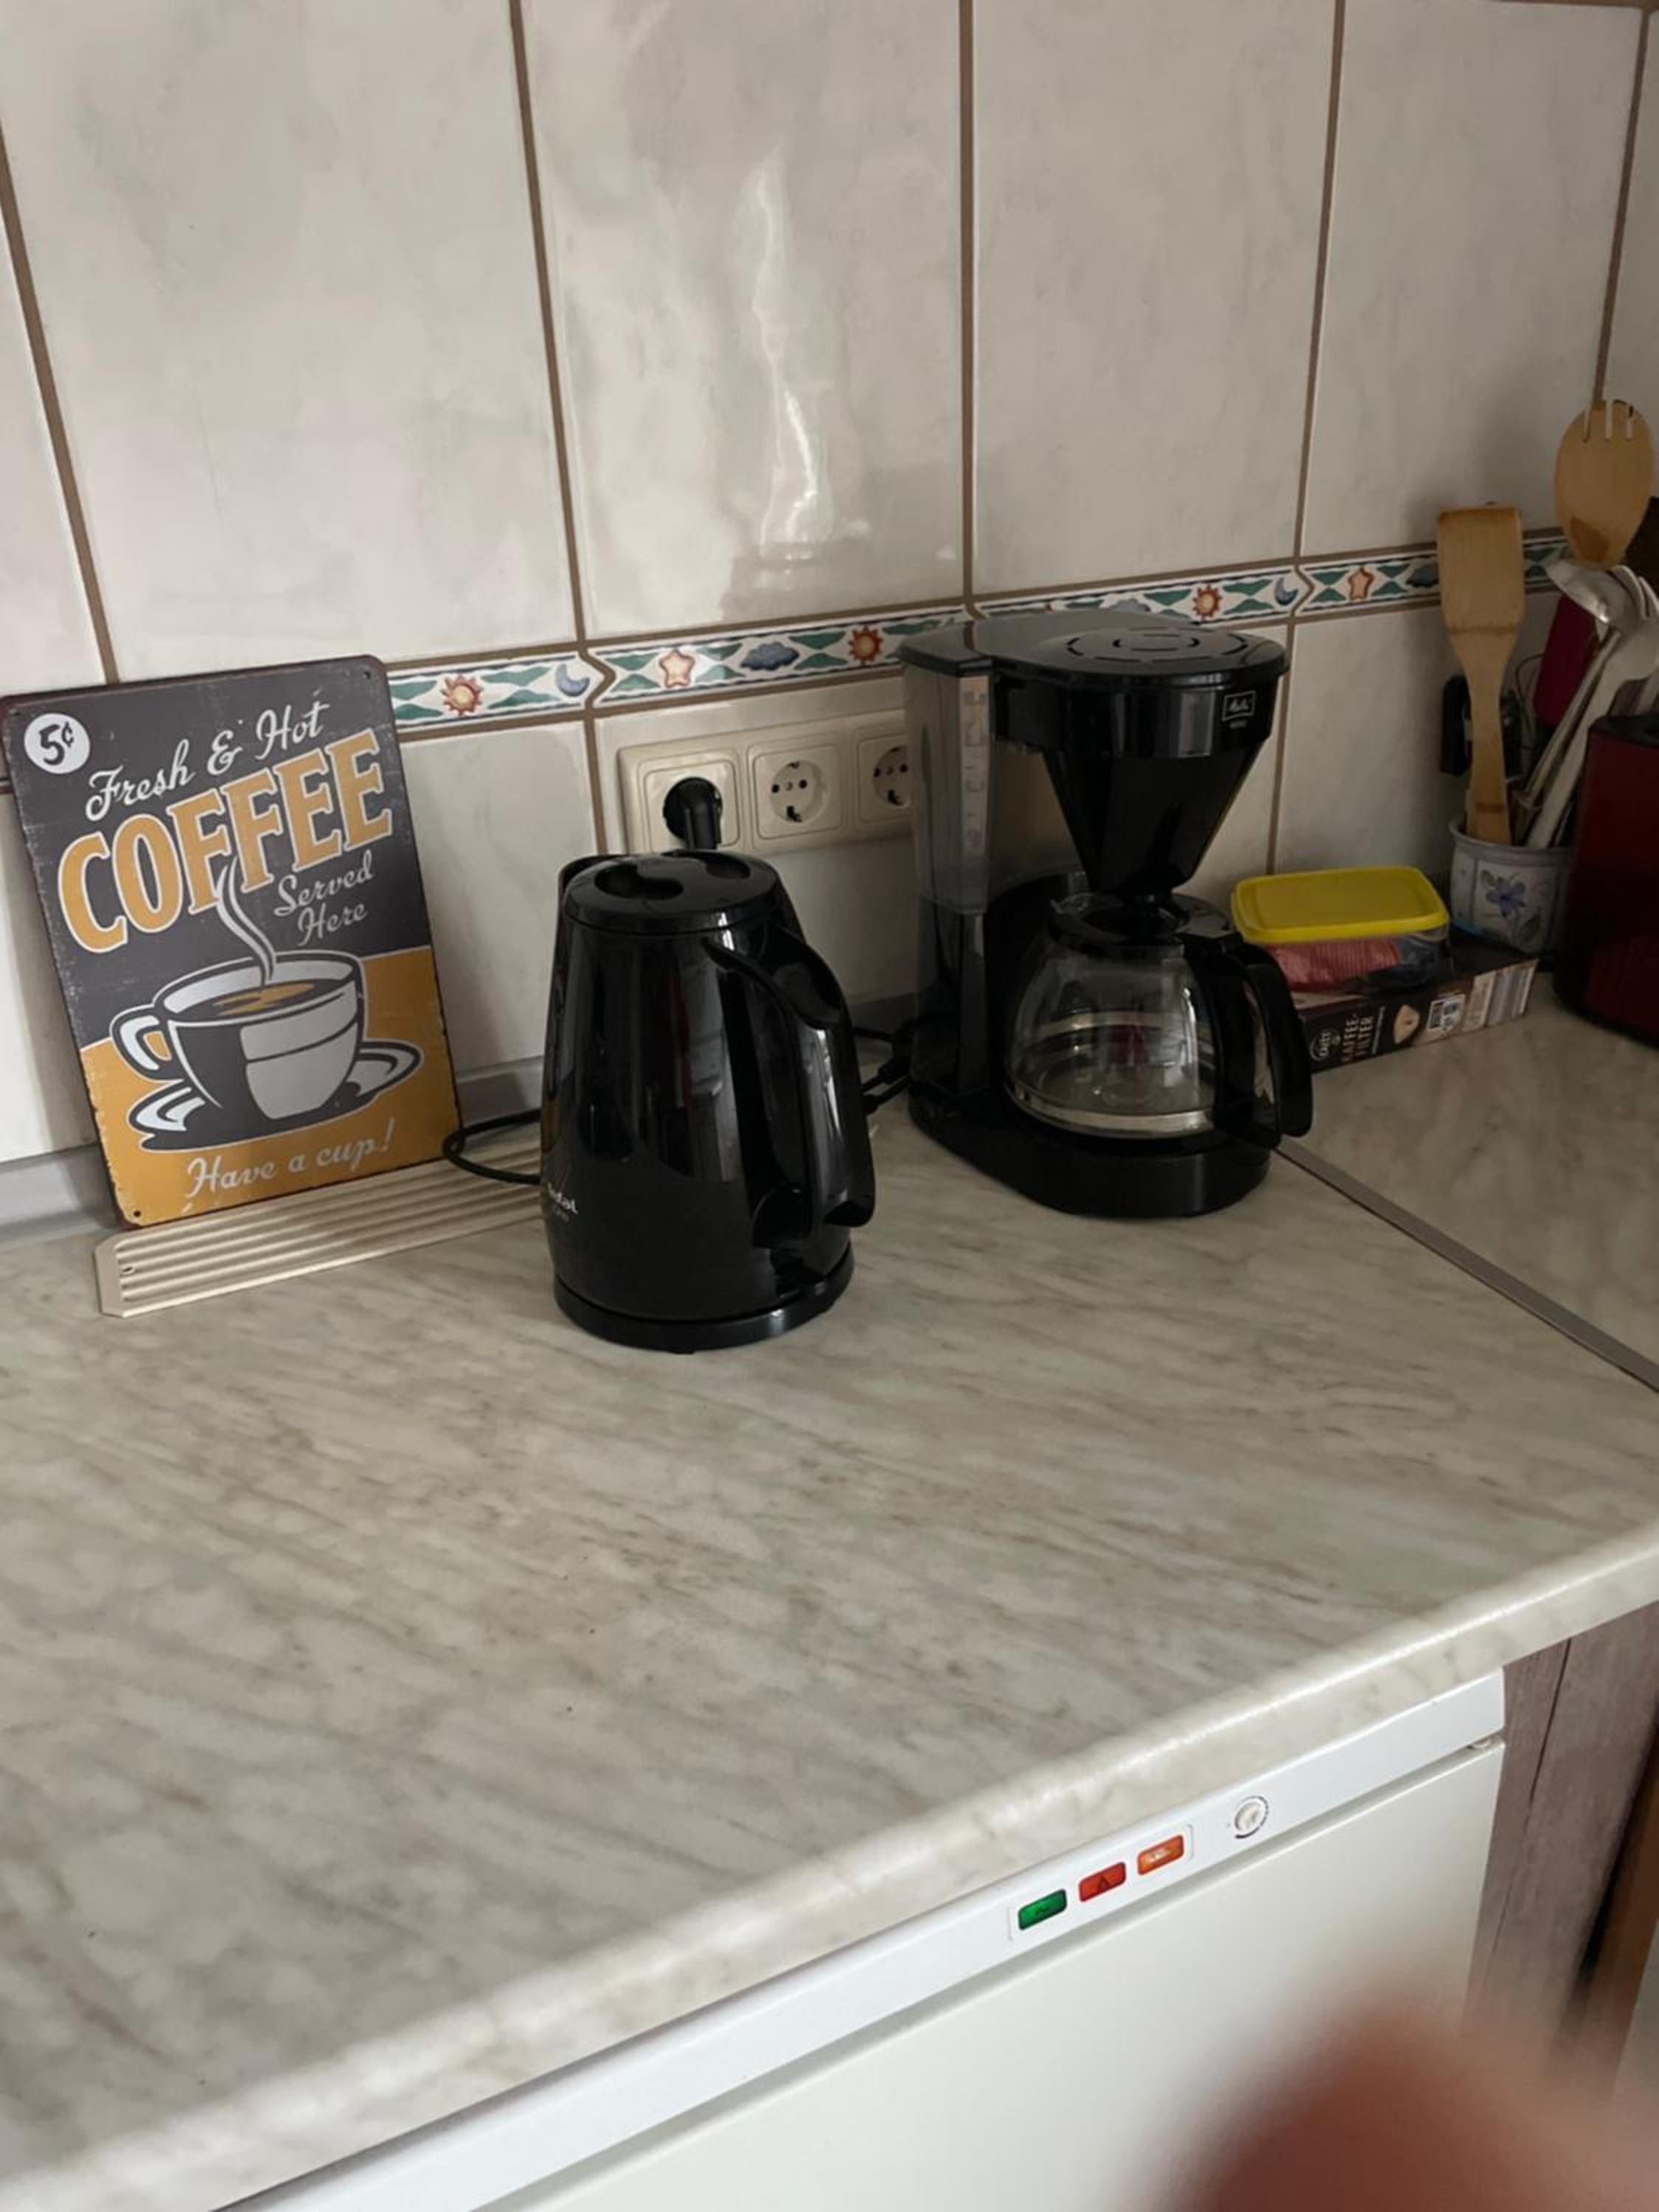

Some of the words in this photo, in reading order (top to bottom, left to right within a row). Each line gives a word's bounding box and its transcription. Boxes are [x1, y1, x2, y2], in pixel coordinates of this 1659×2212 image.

[86, 738, 195, 821] Fresh
[207, 730, 243, 775] &
[254, 698, 330, 760] Hot
[58, 728, 393, 953] COFFEE
[274, 849, 375, 917] Served
[296, 900, 369, 947] Here
[184, 1155, 279, 1199] Have
[288, 1154, 307, 1173] a
[316, 1116, 395, 1172] cup!
